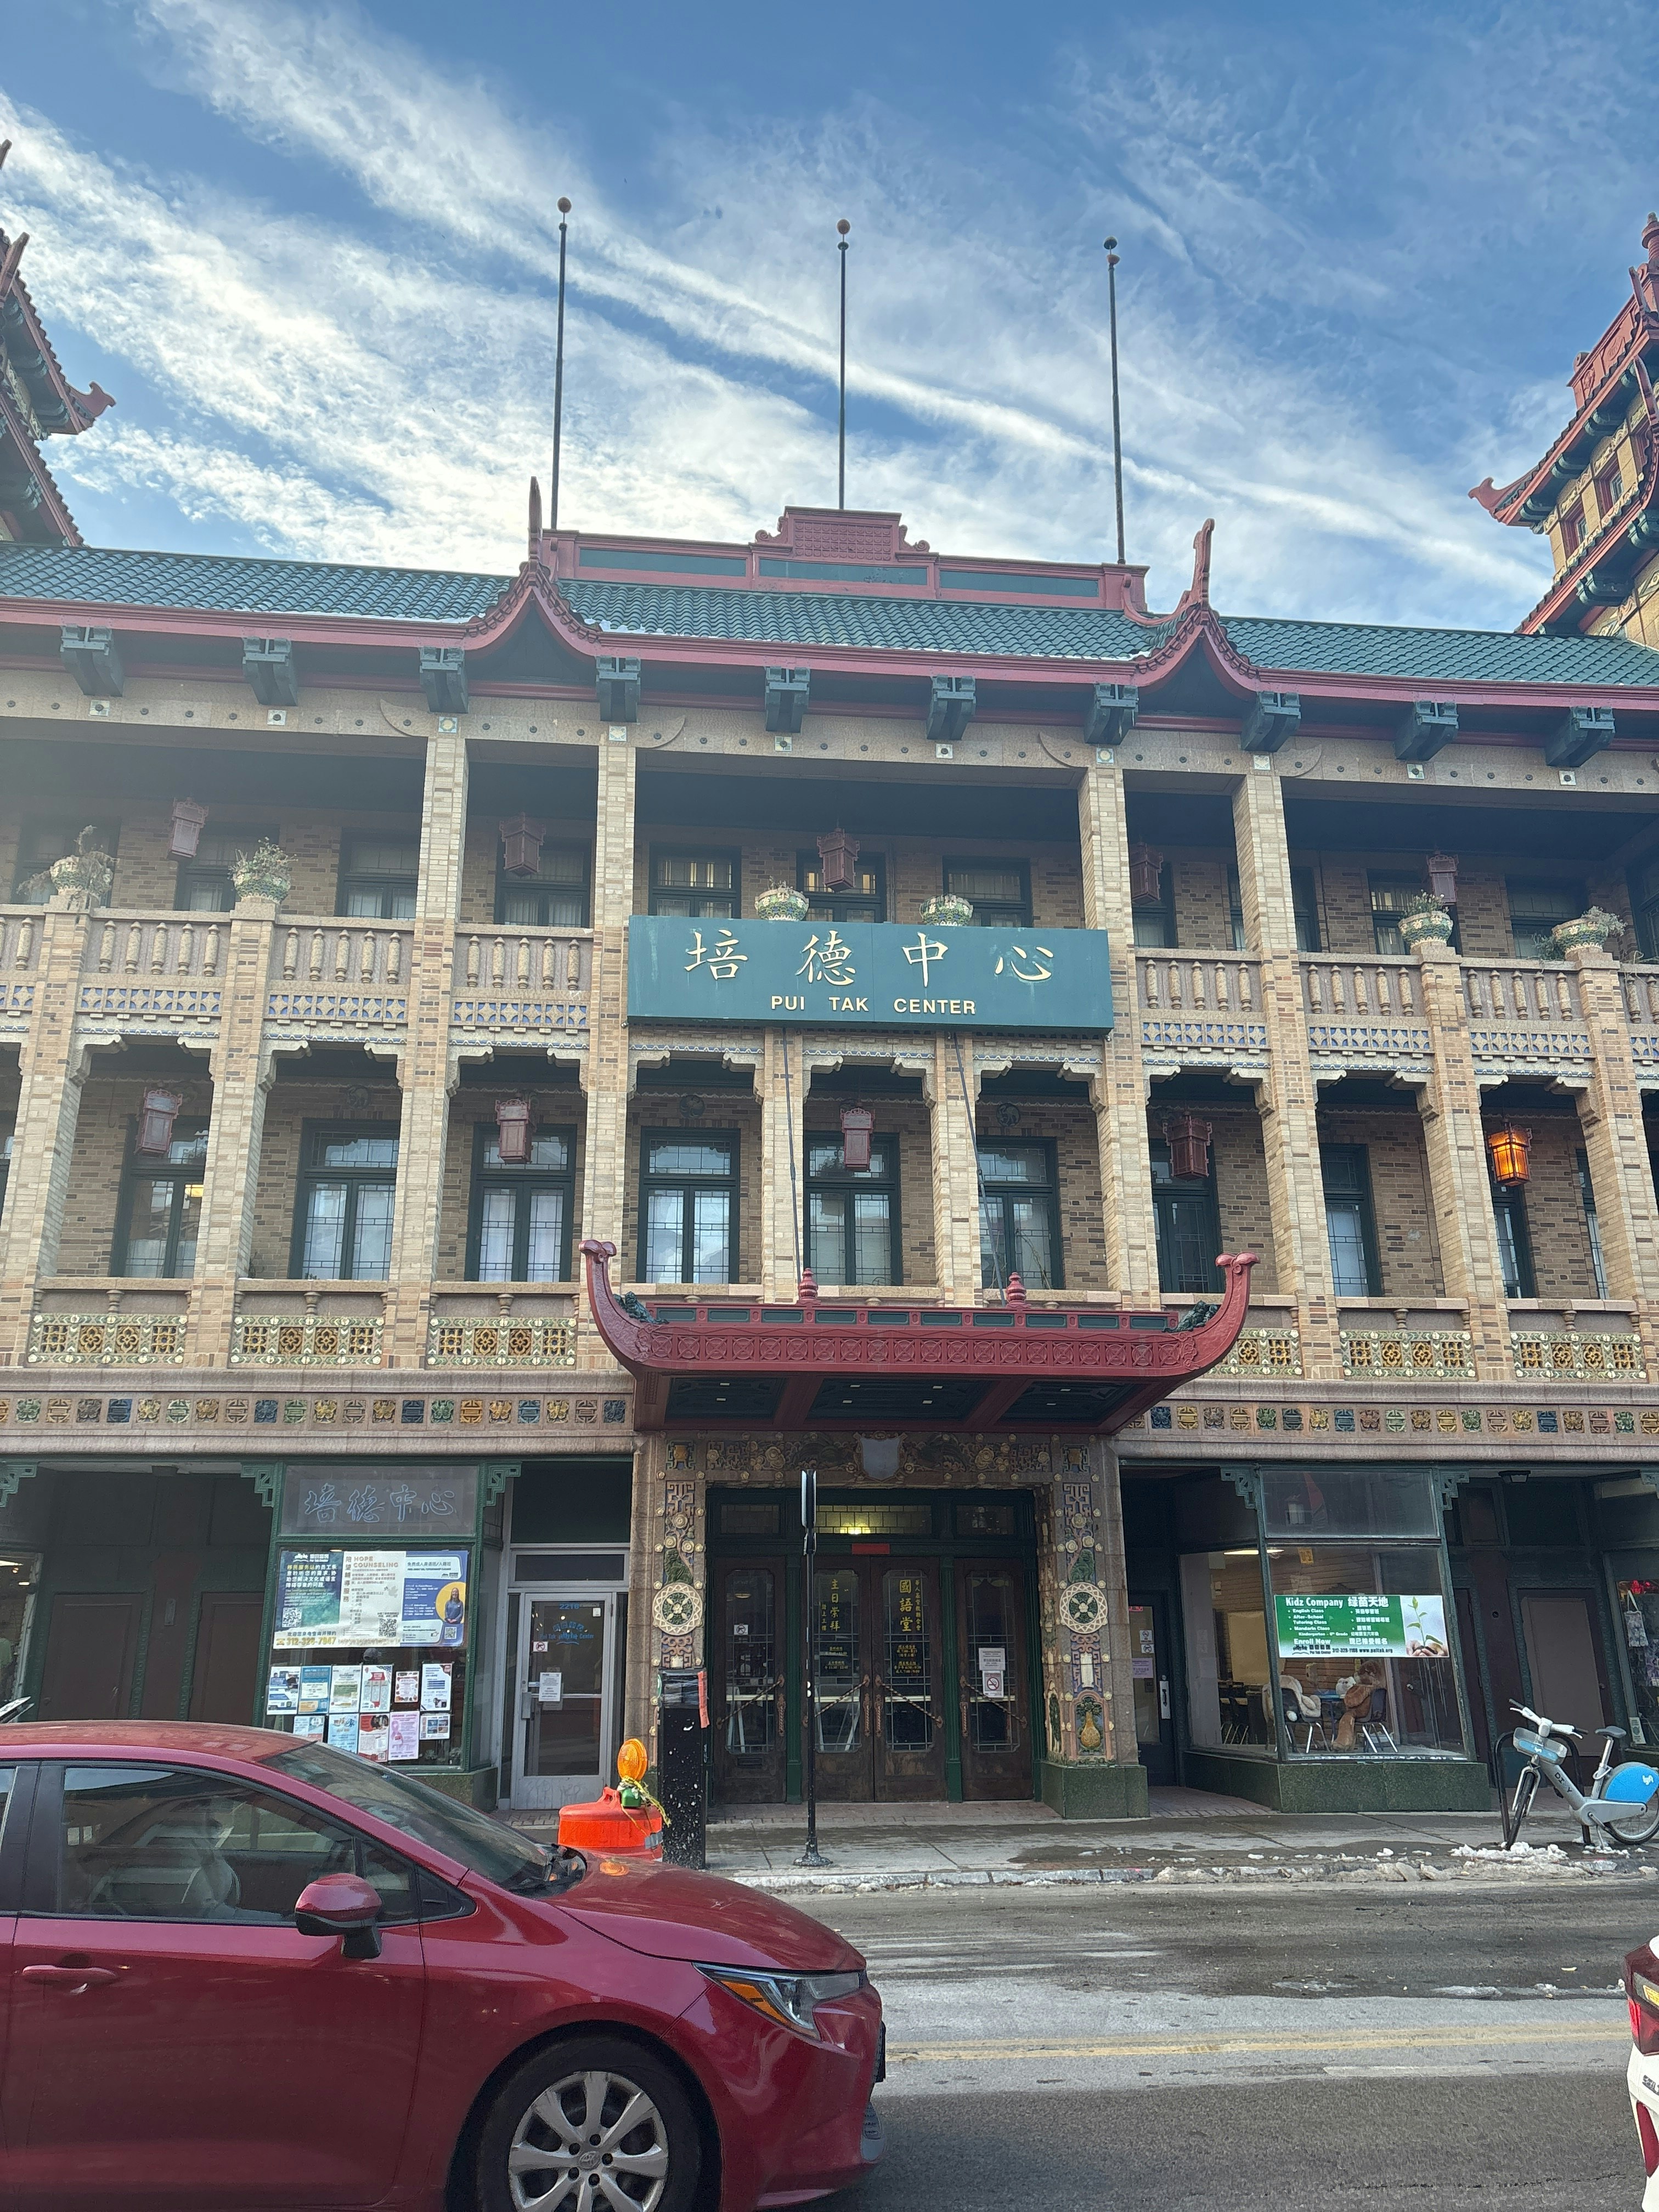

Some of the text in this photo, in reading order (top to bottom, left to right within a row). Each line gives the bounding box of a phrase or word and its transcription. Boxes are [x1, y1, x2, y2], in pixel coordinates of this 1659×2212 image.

[684, 929, 1054, 987] 培德中心
[771, 995, 977, 1015] PUI TAK CENTER
[304, 1483, 455, 1523] 培德中心
[830, 1579, 840, 1632] 主日崇拜
[899, 1579, 913, 1632] 國語堂
[1285, 1597, 1344, 1609] Kidz Company
